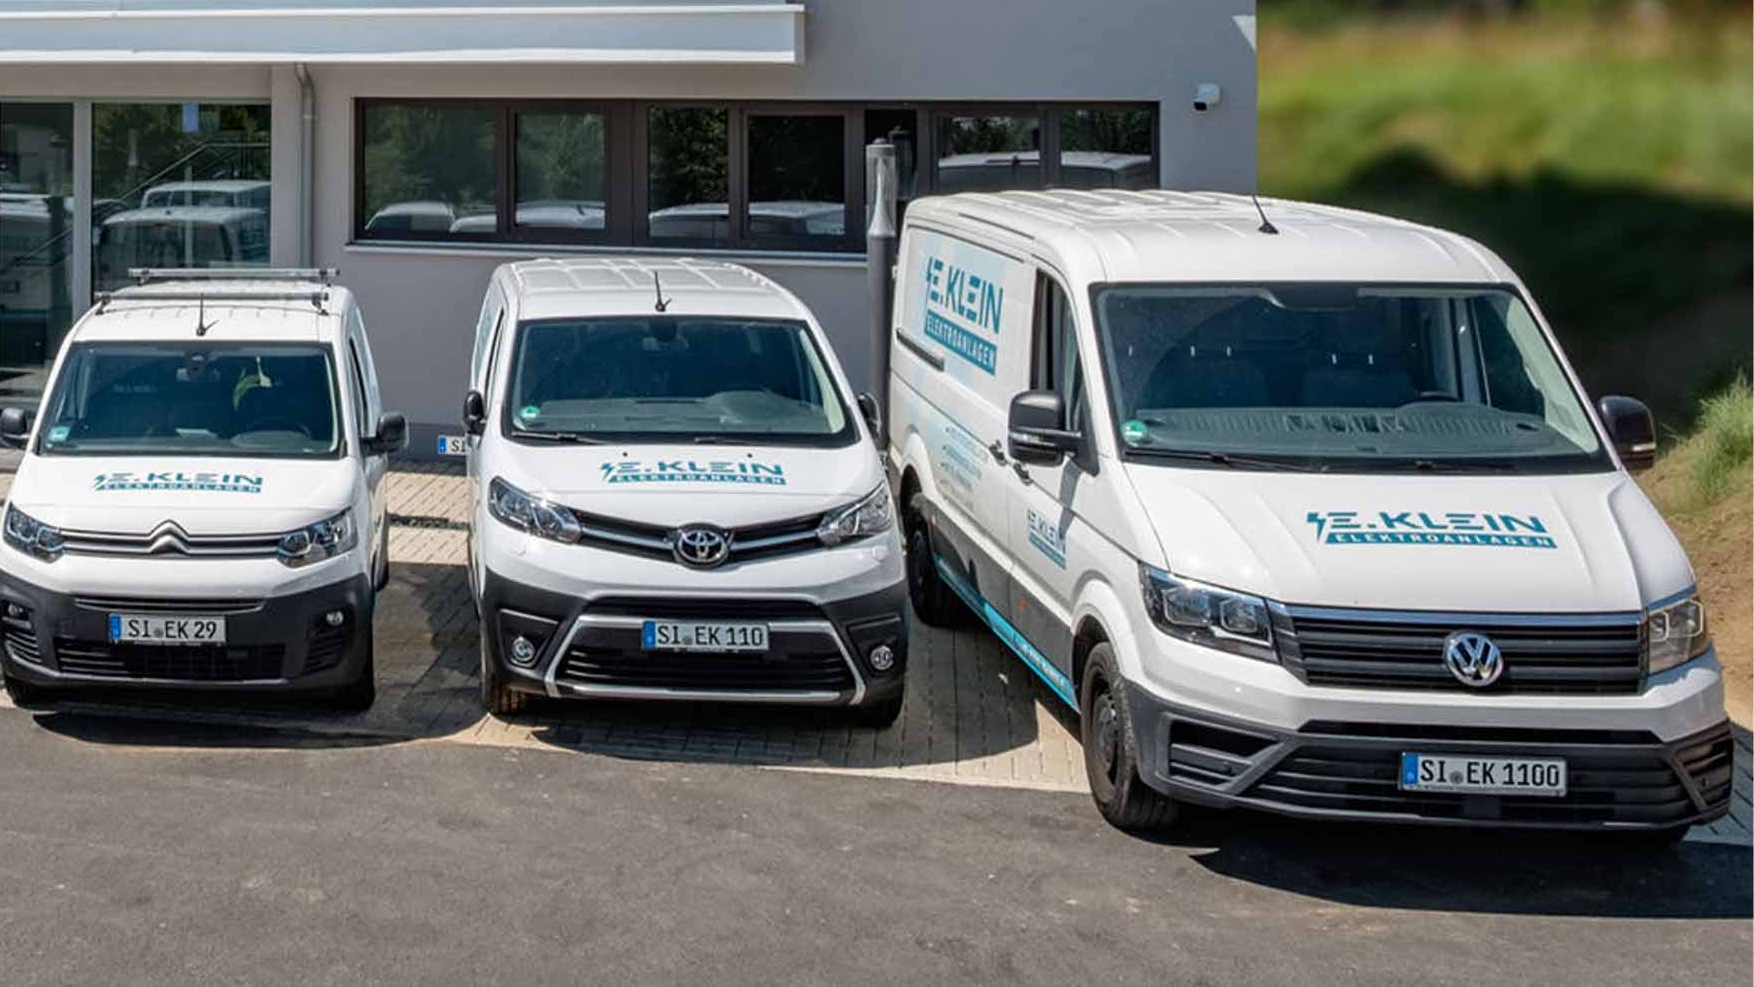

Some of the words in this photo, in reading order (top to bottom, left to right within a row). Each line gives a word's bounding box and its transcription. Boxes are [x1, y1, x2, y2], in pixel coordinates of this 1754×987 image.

[1327, 512, 1547, 534] E.KLEIN
[128, 620, 150, 638] SI
[165, 621, 189, 638] EK
[194, 621, 217, 639] 29
[657, 625, 680, 644] SI
[695, 626, 721, 645] EK
[726, 627, 763, 646] 110
[1420, 759, 1446, 782] SI
[1466, 761, 1495, 784] EK
[1502, 763, 1560, 787] 1100
